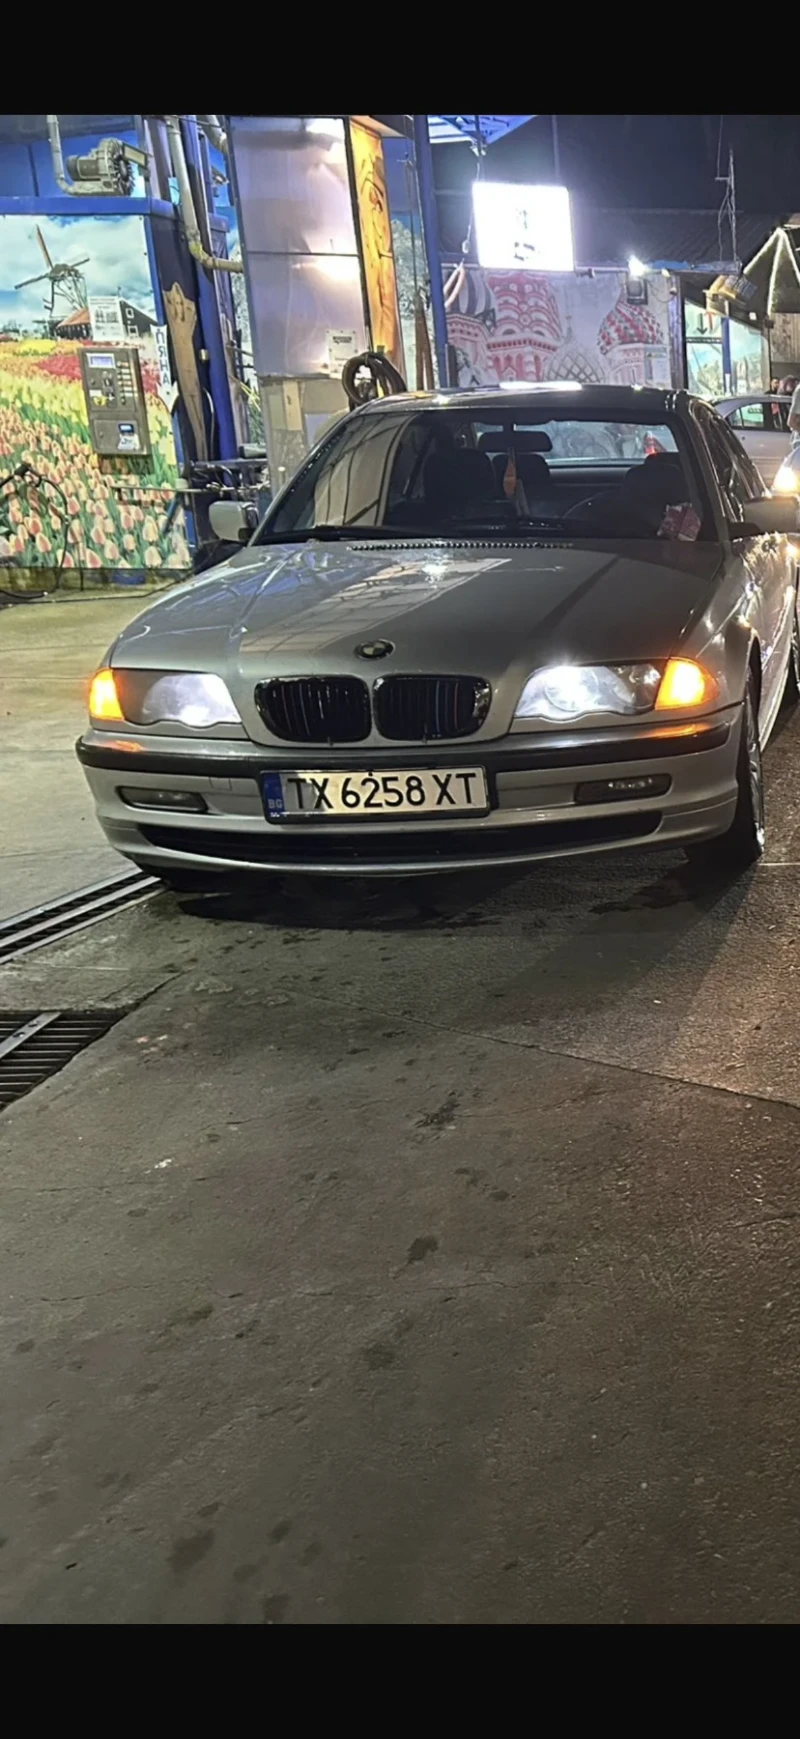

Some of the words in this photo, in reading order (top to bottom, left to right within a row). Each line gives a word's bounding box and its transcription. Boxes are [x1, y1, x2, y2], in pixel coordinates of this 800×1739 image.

[156, 331, 170, 385] ПЯНА
[268, 799, 283, 809] BG
[288, 778, 333, 809] TX
[341, 776, 426, 808] 6258
[432, 773, 476, 805] XT
